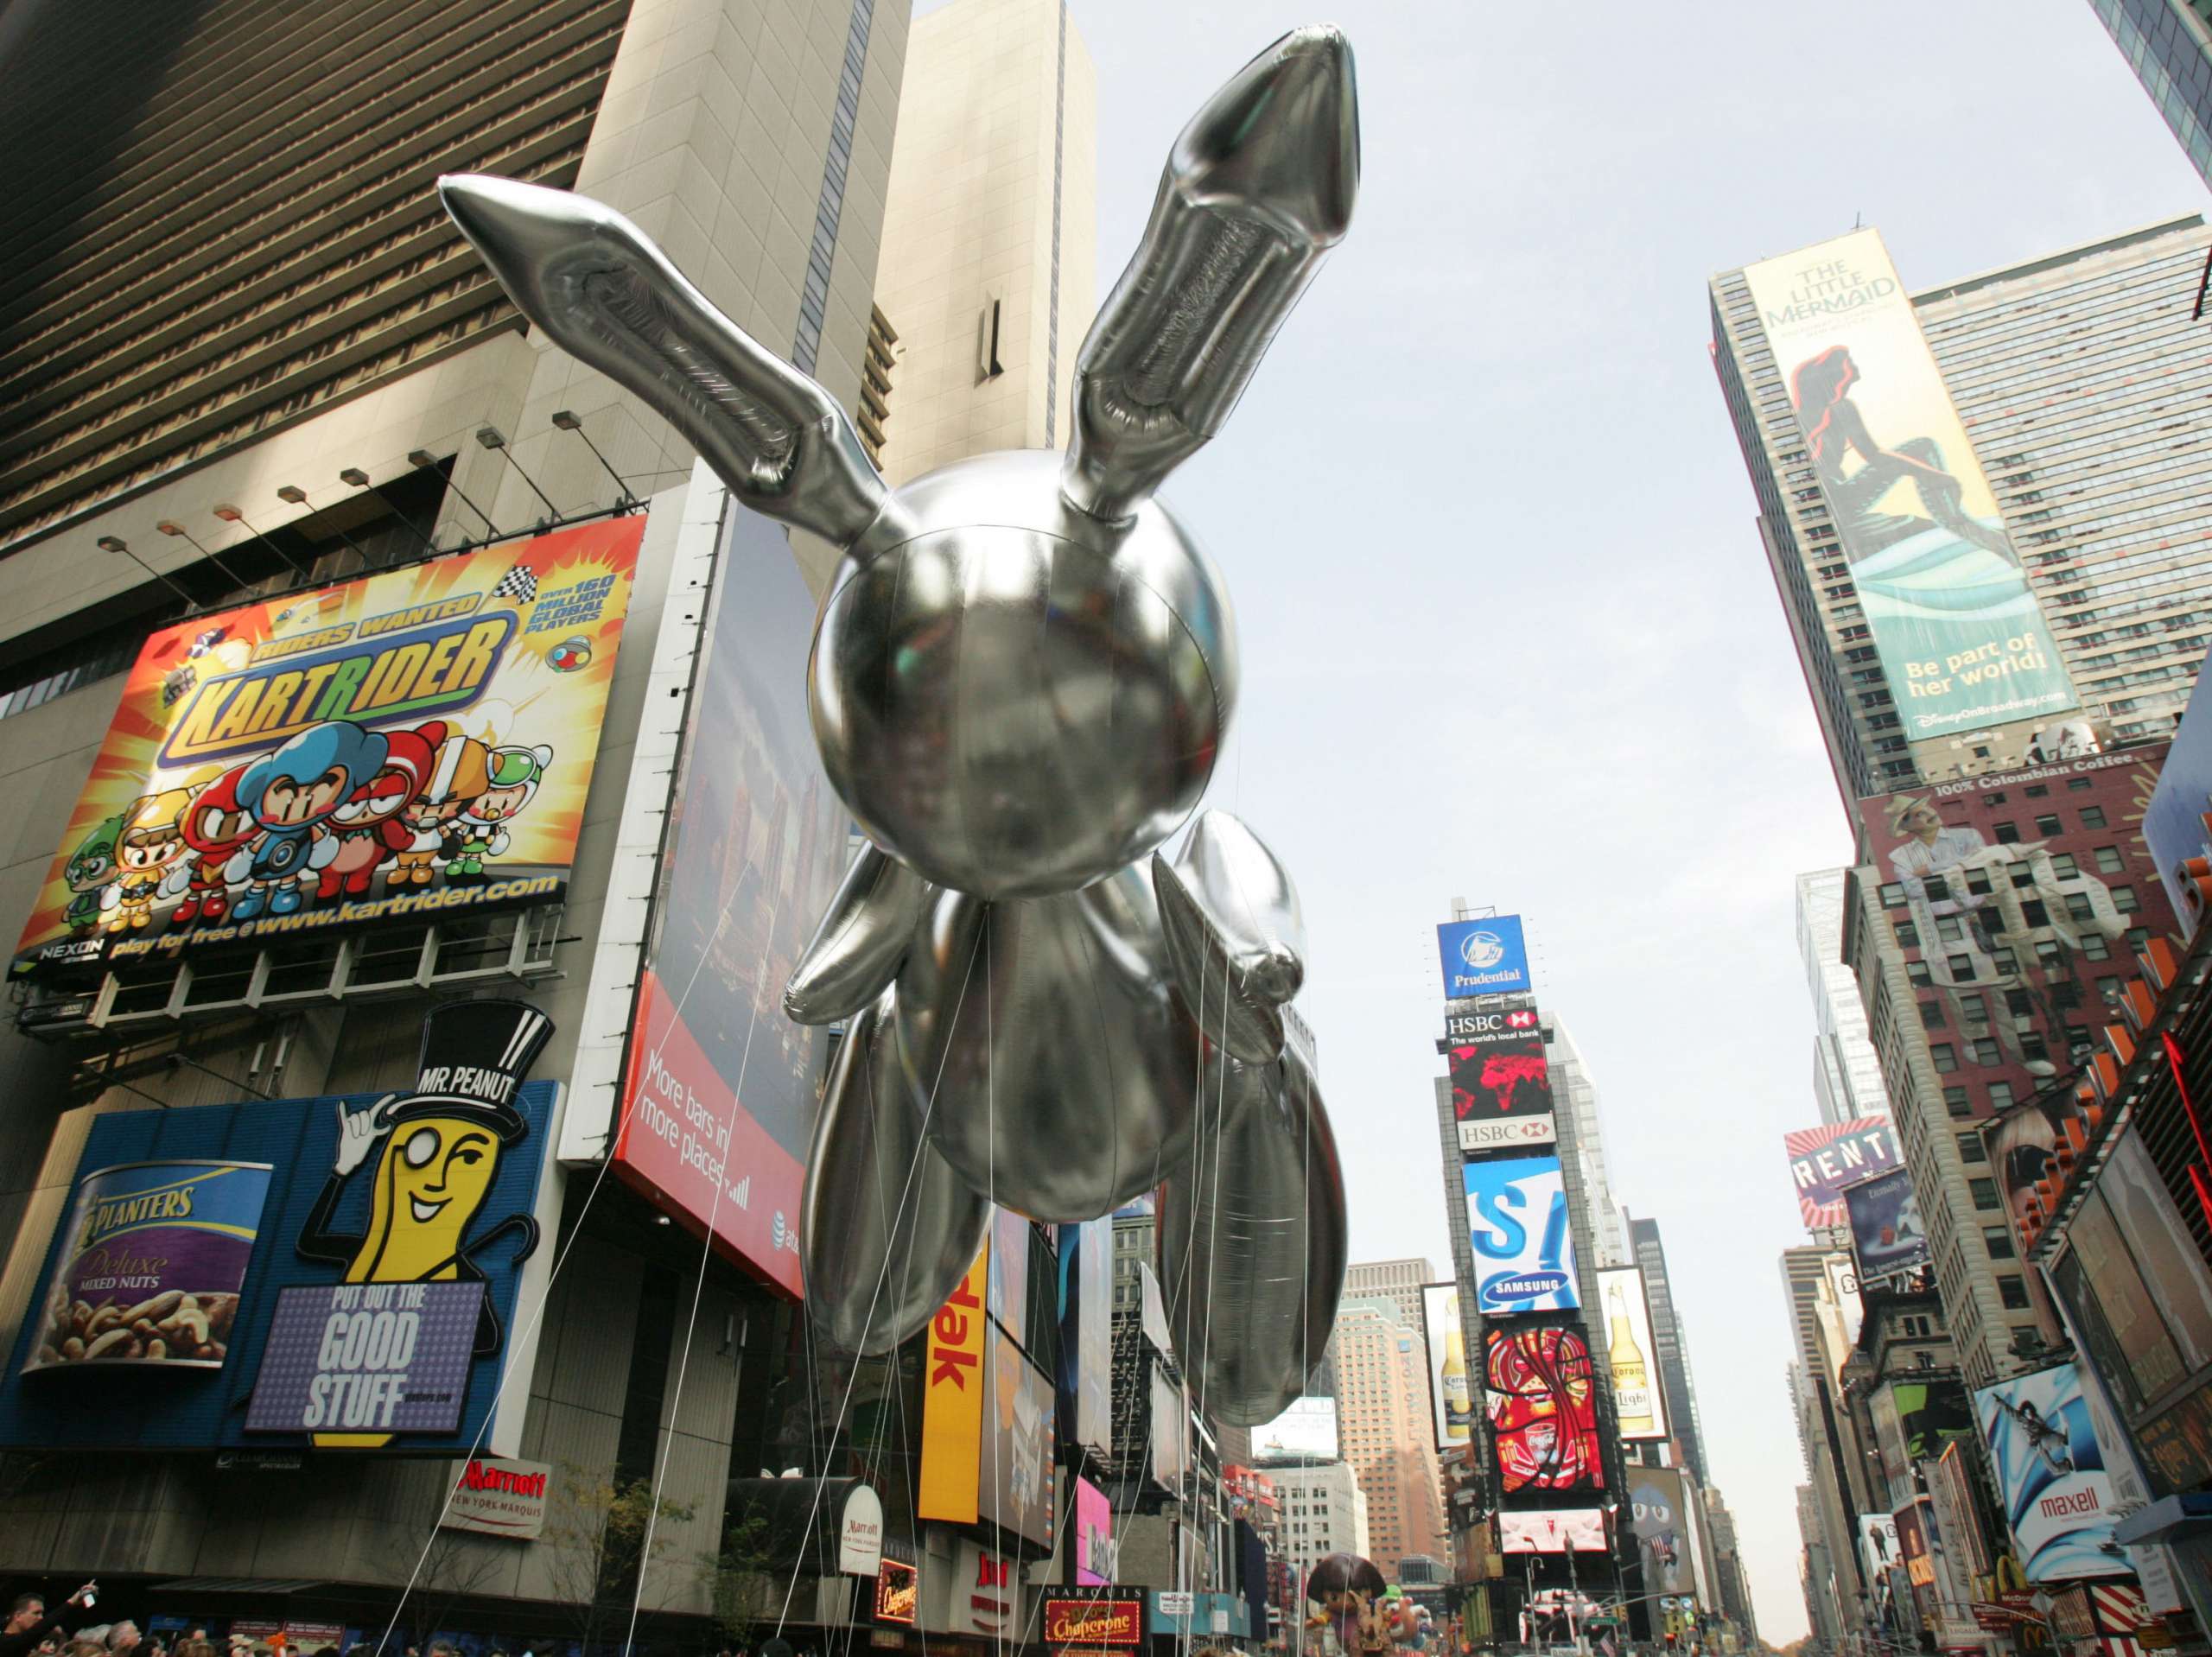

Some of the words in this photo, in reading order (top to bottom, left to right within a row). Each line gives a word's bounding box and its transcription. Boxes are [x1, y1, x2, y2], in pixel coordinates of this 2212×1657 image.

[1796, 259, 1849, 284] THE
[1790, 271, 1866, 303] LITTLE
[1765, 277, 1896, 327] MERMAID
[575, 575, 616, 594] 160
[530, 600, 603, 623] GLOBAL
[536, 587, 610, 612] MILLION
[256, 624, 354, 658] RIDERS
[359, 596, 480, 636] WANTED
[524, 611, 601, 635] PLAYERS
[1905, 662, 1940, 678] Be
[1946, 641, 2001, 673] part
[2006, 632, 2036, 651] of
[1907, 678, 1953, 697] her
[1960, 652, 2048, 685] world!
[1935, 781, 1974, 797] 100%
[1979, 764, 2070, 789] Colombian
[2074, 755, 2133, 771] Coffee
[111, 939, 155, 959] play
[156, 930, 191, 950] for
[191, 927, 240, 945] free
[256, 874, 559, 935] www.kartrider.com
[41, 939, 105, 960] NEXON
[1455, 968, 1521, 987] Prudential
[1449, 1015, 1503, 1034] HSBC
[1468, 1034, 1497, 1044] world's
[416, 1067, 449, 1094] MR.
[449, 1067, 515, 1103] PEANUT
[648, 1049, 683, 1109] More
[685, 1086, 713, 1139] bars
[716, 1118, 730, 1152] in
[640, 1095, 679, 1147] more
[680, 1132, 722, 1187] places
[1465, 1124, 1517, 1142] HSBC
[1792, 1132, 1885, 1189] RENT
[95, 1186, 194, 1235] PLANTERS
[86, 1248, 168, 1275] Deluxe
[79, 1276, 116, 1291] MIXED
[119, 1275, 161, 1288] NUTS
[1496, 1279, 1559, 1293] SAMSUNG
[332, 1286, 364, 1310] PUT
[364, 1285, 396, 1309] OUT
[398, 1284, 428, 1308] THE
[317, 1311, 420, 1370] GOOD
[303, 1374, 408, 1428] STUFF
[458, 1460, 546, 1499] Marriott
[474, 1498, 497, 1509] YORK
[500, 1503, 542, 1517] MARQUIS
[2040, 1487, 2100, 1518] maxell
[1046, 1588, 1141, 1597] MARQUIS
[1053, 1614, 1130, 1641] Chaperone
